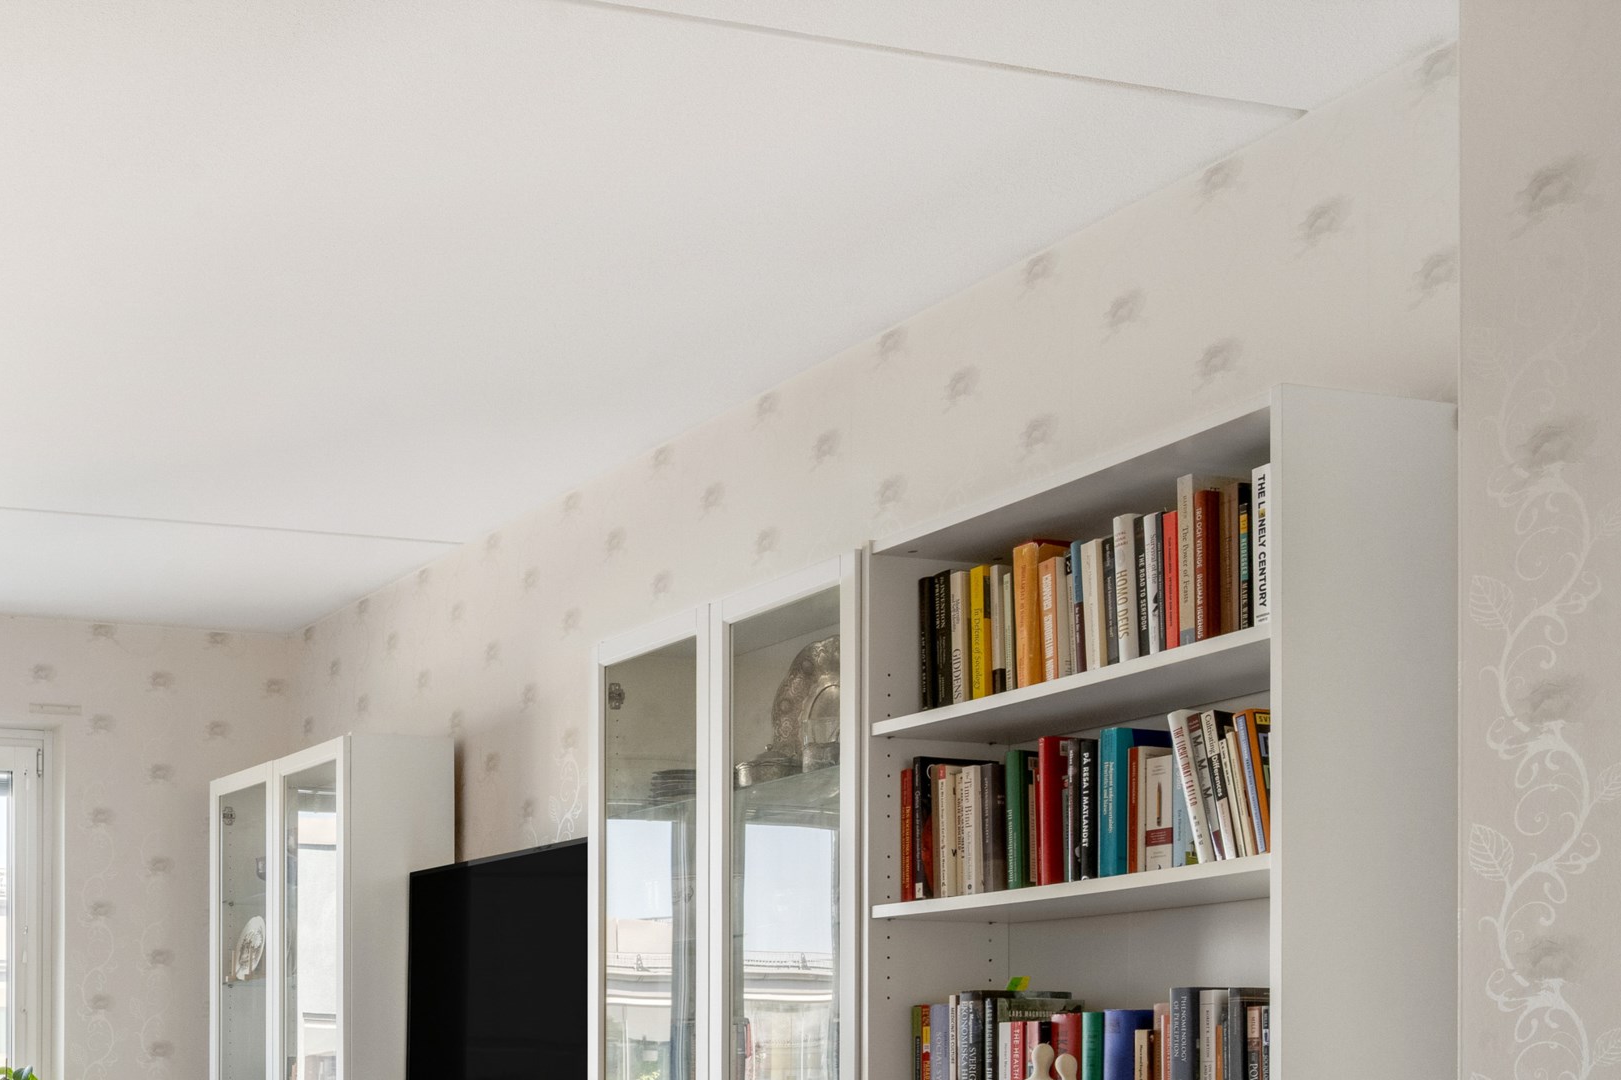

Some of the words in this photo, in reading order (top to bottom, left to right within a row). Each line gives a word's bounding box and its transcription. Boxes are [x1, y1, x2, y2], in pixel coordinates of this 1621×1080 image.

[1257, 473, 1267, 499] THE
[1195, 507, 1204, 521] TRO
[1181, 525, 1190, 542] The
[1195, 521, 1204, 538] OCH
[1138, 552, 1146, 568] THE
[1149, 533, 1158, 564] Survival
[1180, 542, 1190, 568] Power
[1195, 538, 1204, 569] VETANDE
[1138, 569, 1146, 587] ROAD
[1150, 563, 1159, 573] of
[1150, 572, 1159, 585] the
[1181, 568, 1190, 579] of
[1257, 551, 1267, 608] CENTURY
[1041, 573, 1053, 611] GRAMSCI
[1115, 569, 1129, 605] HOMO
[1138, 588, 1146, 598] TO
[1181, 579, 1191, 604] Feasts
[1240, 582, 1249, 604] MARK
[933, 583, 941, 631] PREHISTORY
[938, 584, 947, 630] INVENTION
[972, 607, 983, 616] In
[1139, 599, 1148, 631] SERFDOM
[972, 617, 983, 647] Defence
[1042, 614, 1055, 659] NOTEBOOKS
[1117, 607, 1130, 641] DEUS
[972, 648, 983, 656] of
[951, 648, 963, 701] GIDDENS
[972, 655, 983, 692] Sociology
[1173, 726, 1185, 739] THE
[1204, 713, 1218, 755] Cultivating
[1081, 751, 1092, 765] PÅ
[1176, 740, 1189, 760] LIGHT
[1081, 766, 1090, 789] RESA
[1102, 761, 1110, 789] Heuristics
[1180, 762, 1193, 778] THAT
[1210, 755, 1224, 798] Differences
[964, 778, 973, 804] Time
[1102, 788, 1110, 800] and
[964, 805, 973, 829] Bind
[1006, 808, 1014, 820] tid
[1102, 799, 1110, 816] biases
[1081, 796, 1090, 848] MATLANDET
[1006, 819, 1014, 883] Industrialismens
[1008, 1010, 1023, 1018] LARS
[1173, 1000, 1180, 1010] OF
[960, 1000, 969, 1066] EKONOMISKA
[1012, 1028, 1020, 1045] THE
[1180, 995, 1188, 1062] PHENOMENOLOGY
[935, 1031, 943, 1067] SOCIAL
[1012, 1046, 1020, 1079] HEALTH
